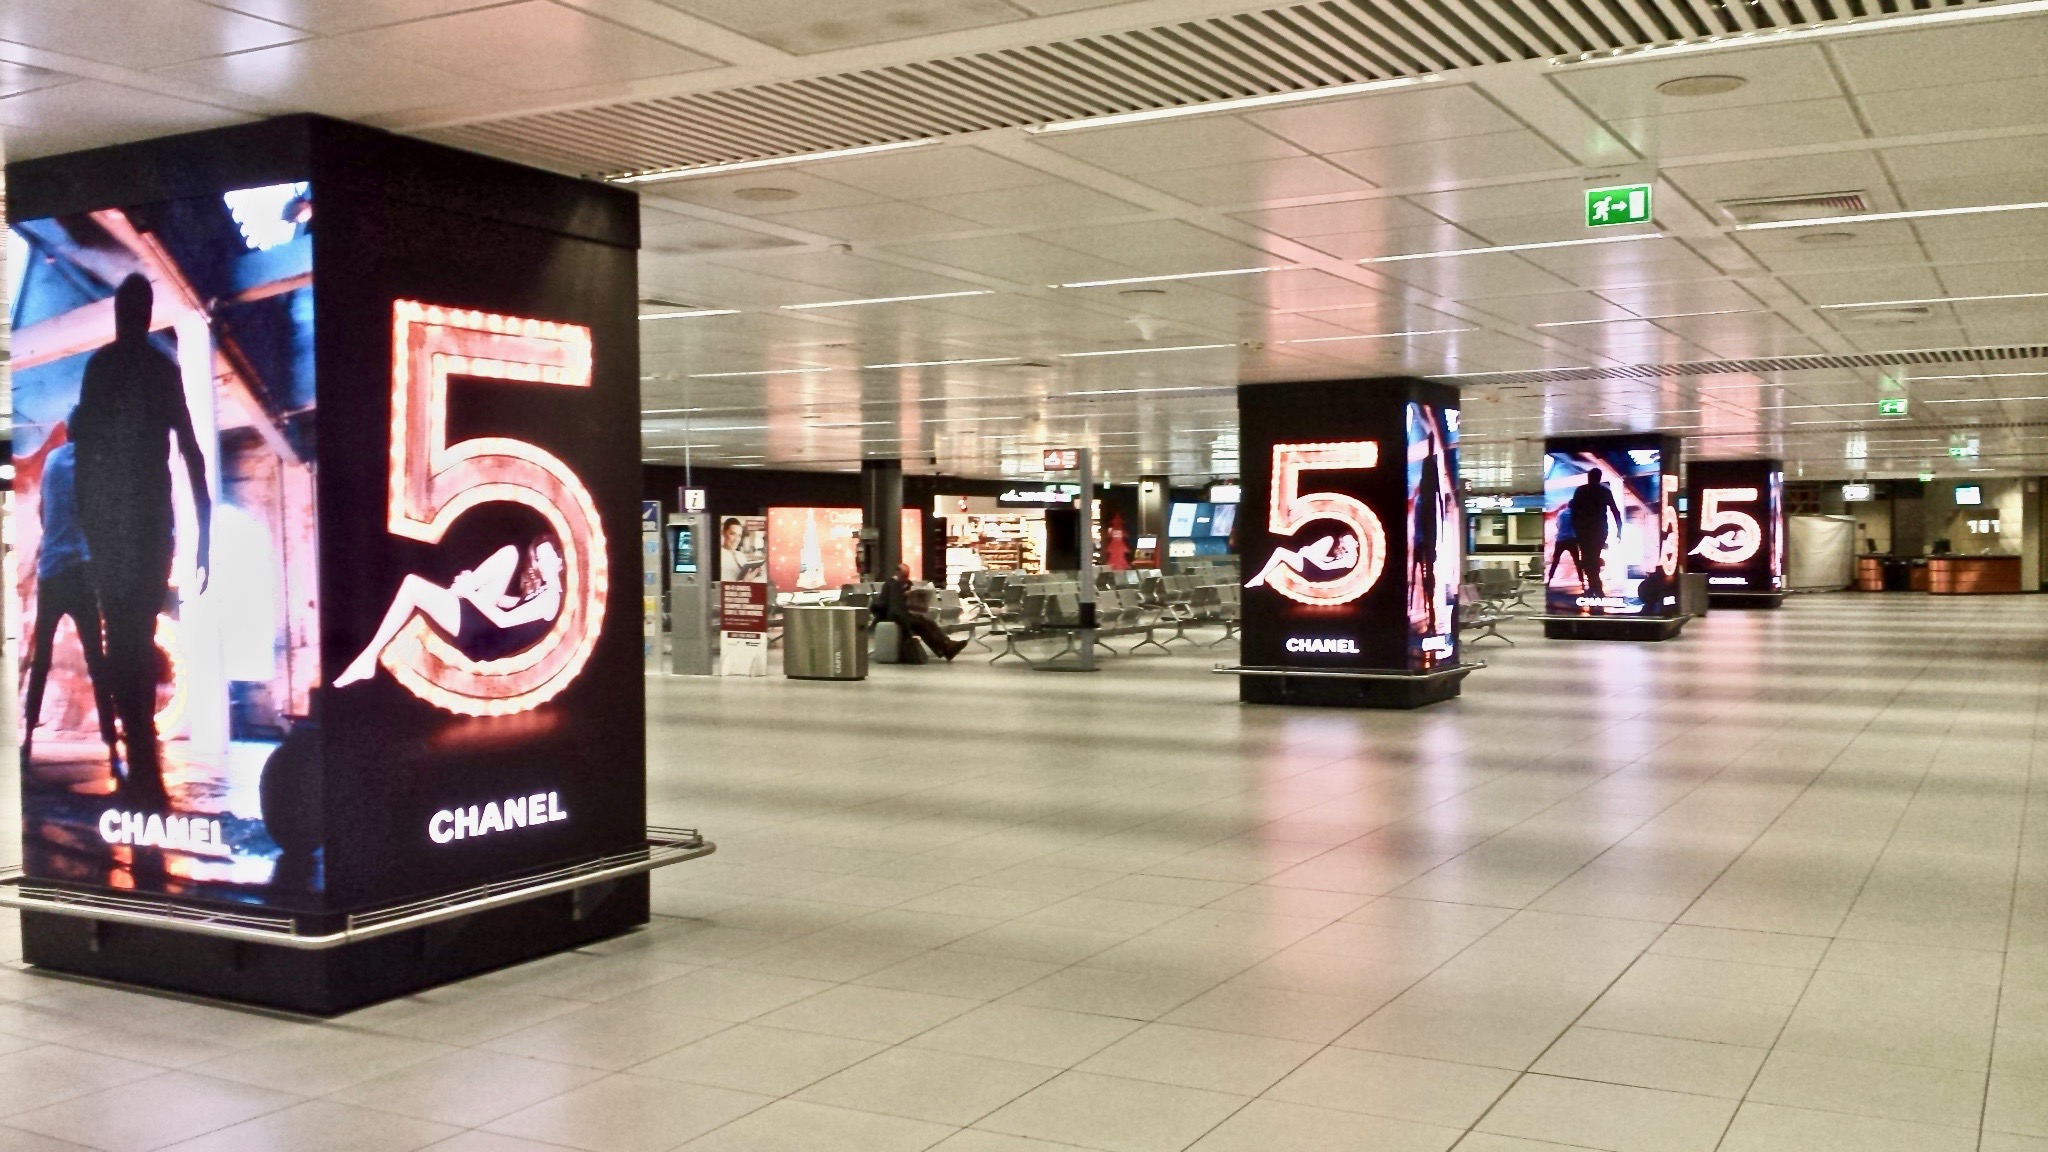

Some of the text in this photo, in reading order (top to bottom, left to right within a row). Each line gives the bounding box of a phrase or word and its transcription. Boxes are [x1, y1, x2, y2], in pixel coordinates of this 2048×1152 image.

[379, 298, 608, 718] 5
[1265, 441, 1386, 606] 5
[1700, 487, 1762, 564] 5
[1285, 637, 1360, 654] CHANEL
[98, 808, 232, 857] CHANEL
[428, 790, 568, 845] CHANEL
